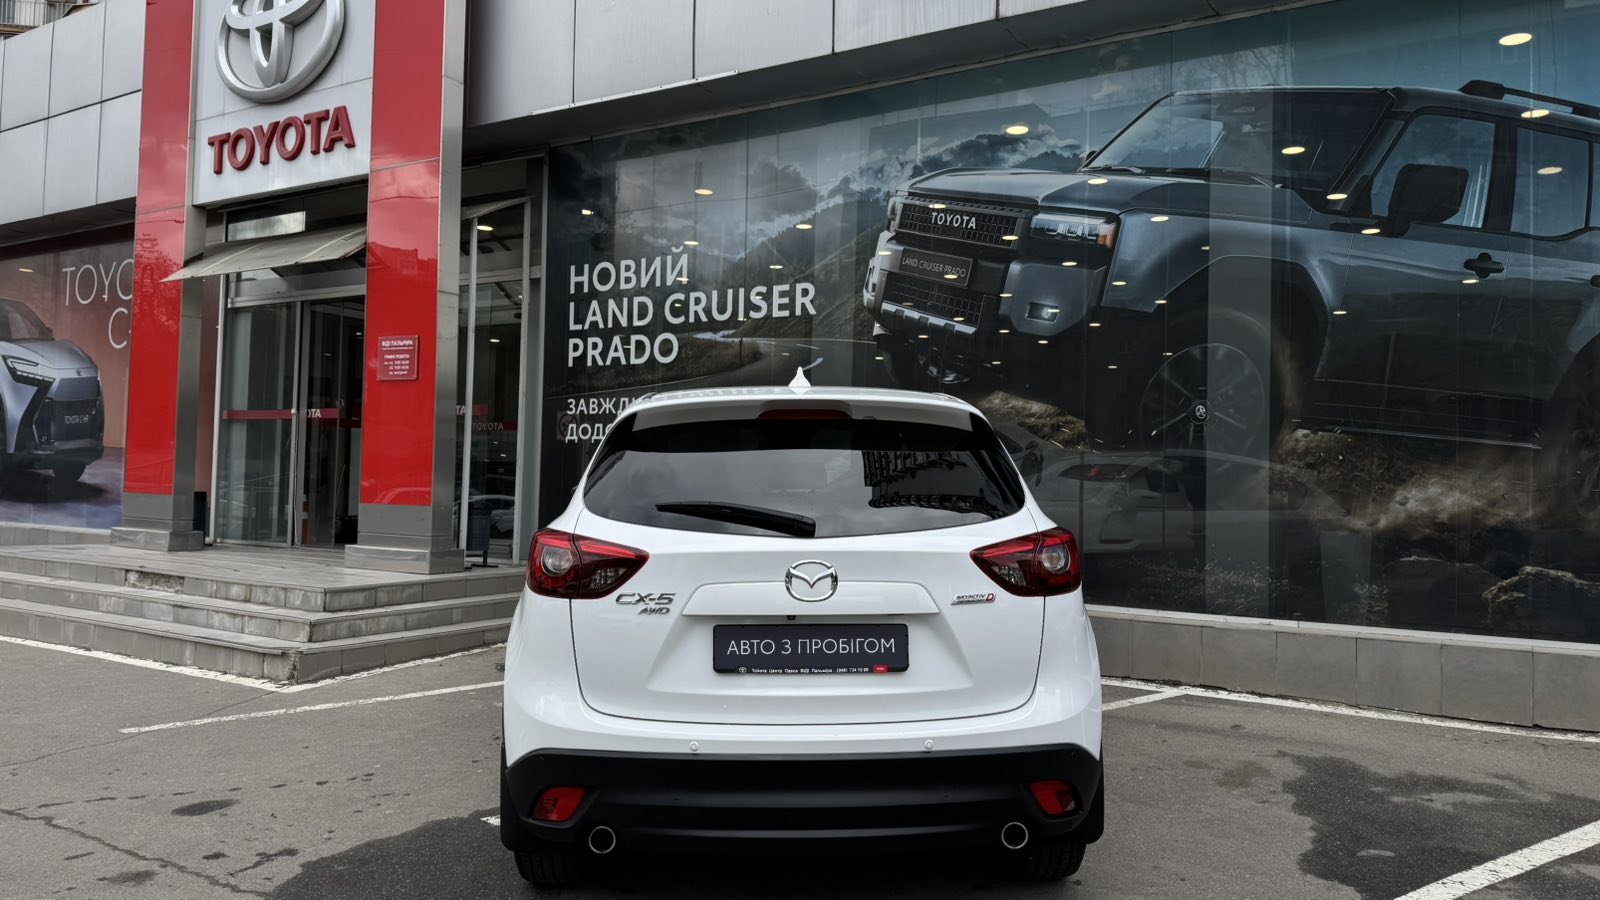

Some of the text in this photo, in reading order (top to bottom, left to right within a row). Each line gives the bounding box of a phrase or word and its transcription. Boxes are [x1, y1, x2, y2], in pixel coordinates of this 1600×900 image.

[208, 105, 356, 175] TOYOTA
[931, 212, 976, 230] TOYOTA
[569, 245, 689, 294] НОВИЙ
[902, 256, 967, 278] LAND CRUISER PRADO
[569, 282, 817, 331] LAND CRUISER
[567, 332, 679, 367] PRADO
[472, 422, 504, 431] TOYOTA
[616, 592, 676, 606] CX-5
[639, 607, 670, 615] AWD
[727, 640, 776, 655] АВТО
[798, 638, 896, 654] ПРОБІГОМ
